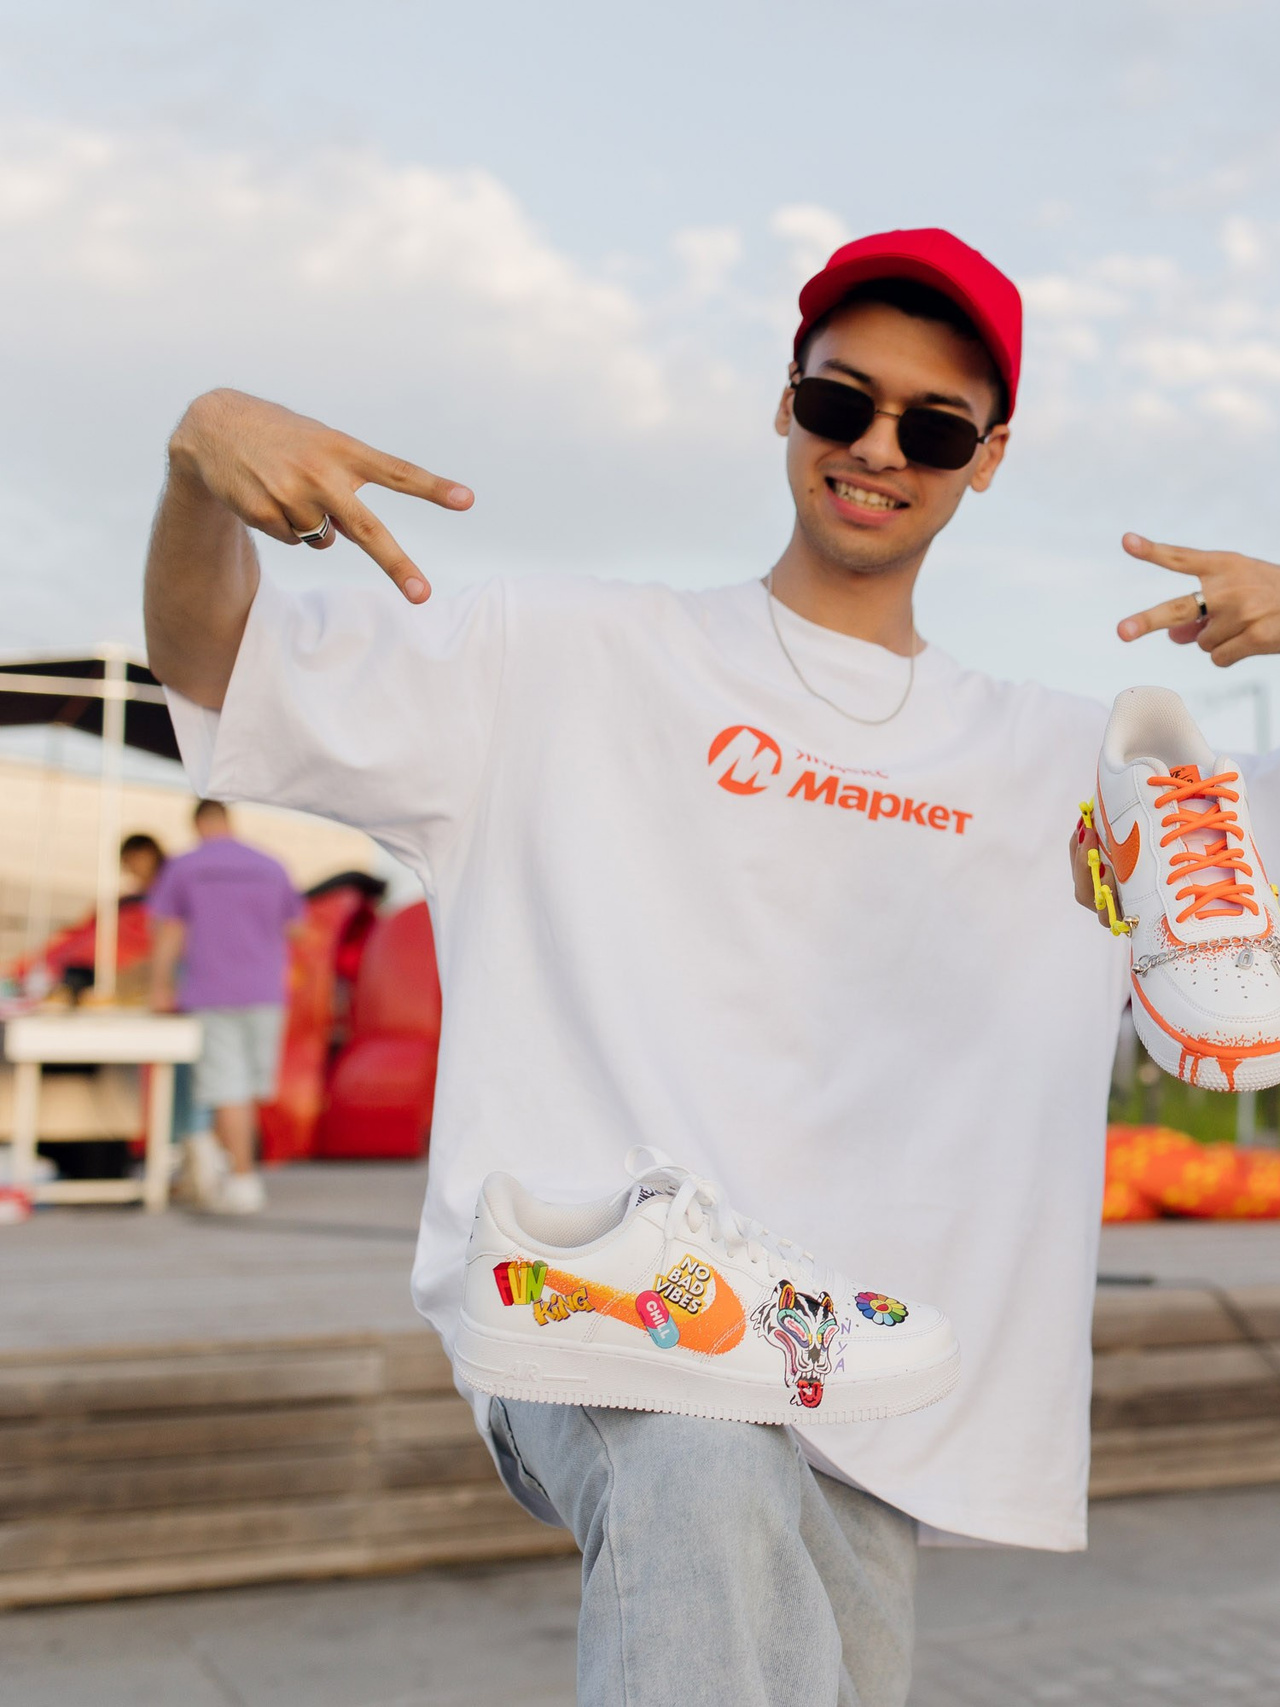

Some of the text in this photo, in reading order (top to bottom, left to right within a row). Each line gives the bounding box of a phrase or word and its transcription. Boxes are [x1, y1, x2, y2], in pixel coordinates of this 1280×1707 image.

[786, 770, 974, 836] Маркет
[492, 1260, 548, 1306] FUN
[667, 1268, 704, 1297] BAD
[680, 1256, 710, 1282] NO
[655, 1277, 702, 1315] VIBES
[646, 1300, 670, 1339] CHILL
